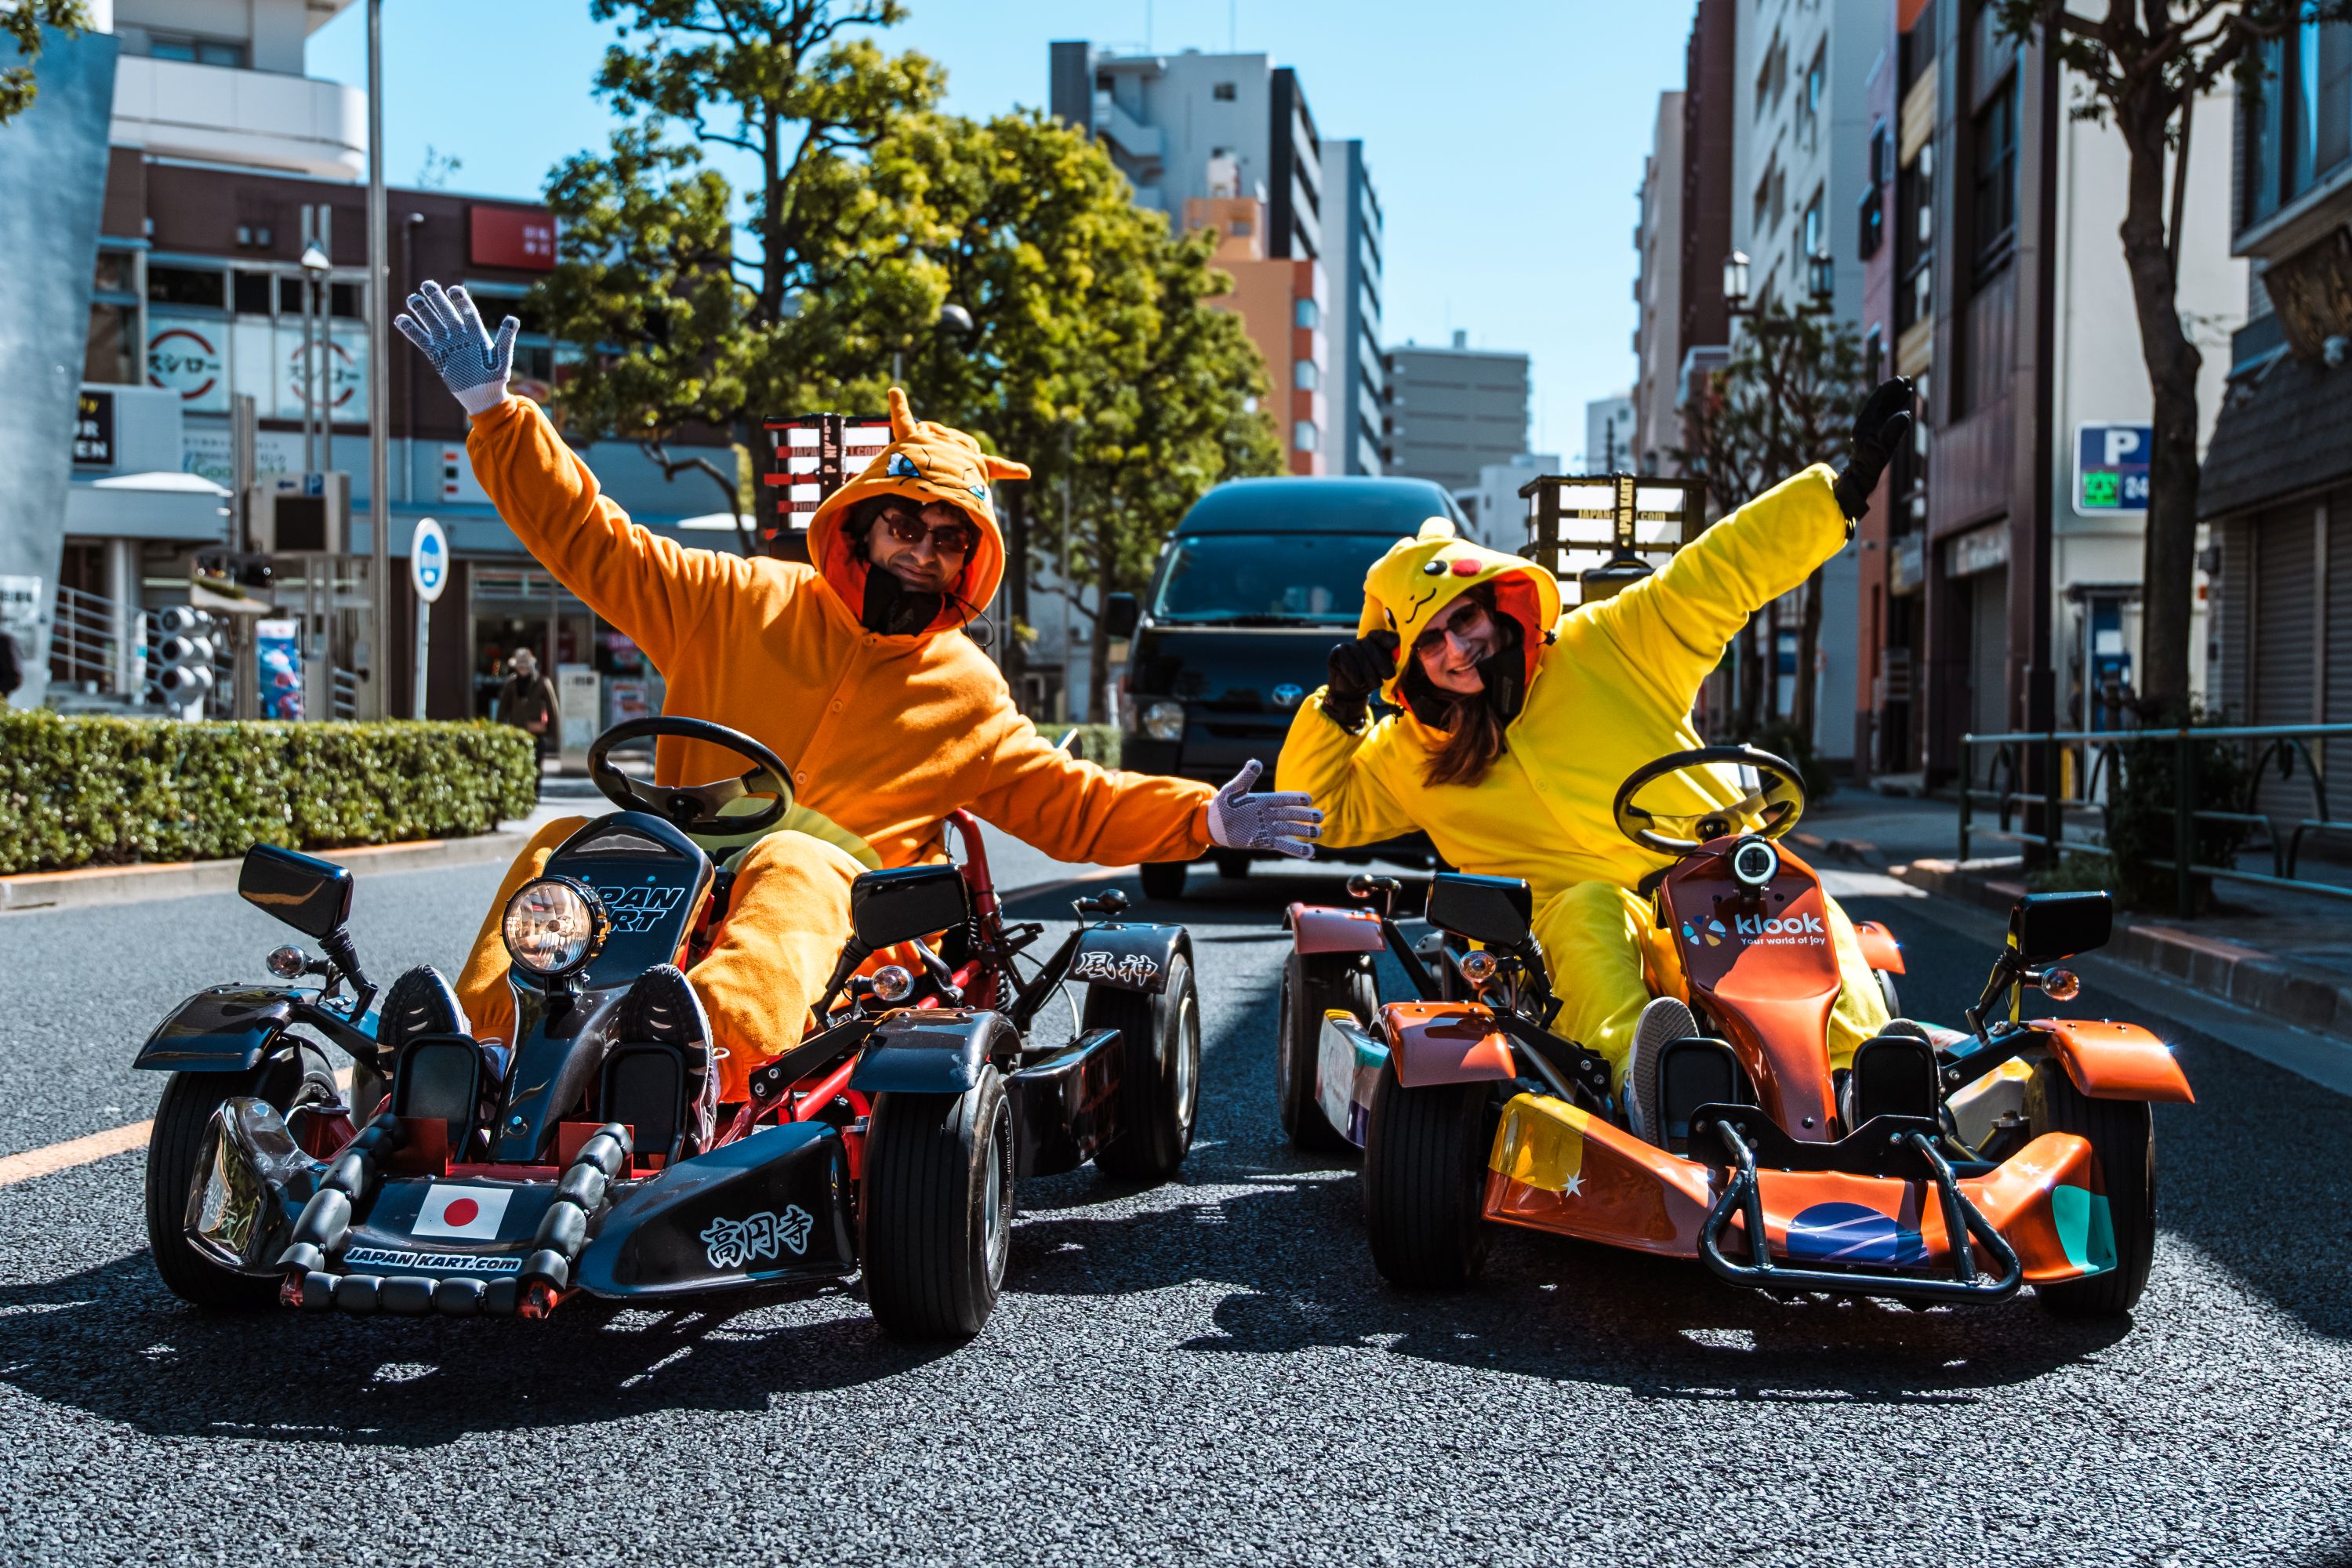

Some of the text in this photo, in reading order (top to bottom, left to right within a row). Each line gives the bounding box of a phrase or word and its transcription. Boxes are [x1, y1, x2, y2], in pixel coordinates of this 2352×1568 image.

[2104, 430, 2140, 465] P
[597, 887, 684, 909] PAN
[610, 909, 666, 931] RT
[1734, 913, 1824, 934] klook
[1809, 935, 1825, 946] joy
[1075, 951, 1158, 986] 風神
[700, 1204, 814, 1269] 高円寺
[343, 1247, 522, 1272] JAPAN KART.com
